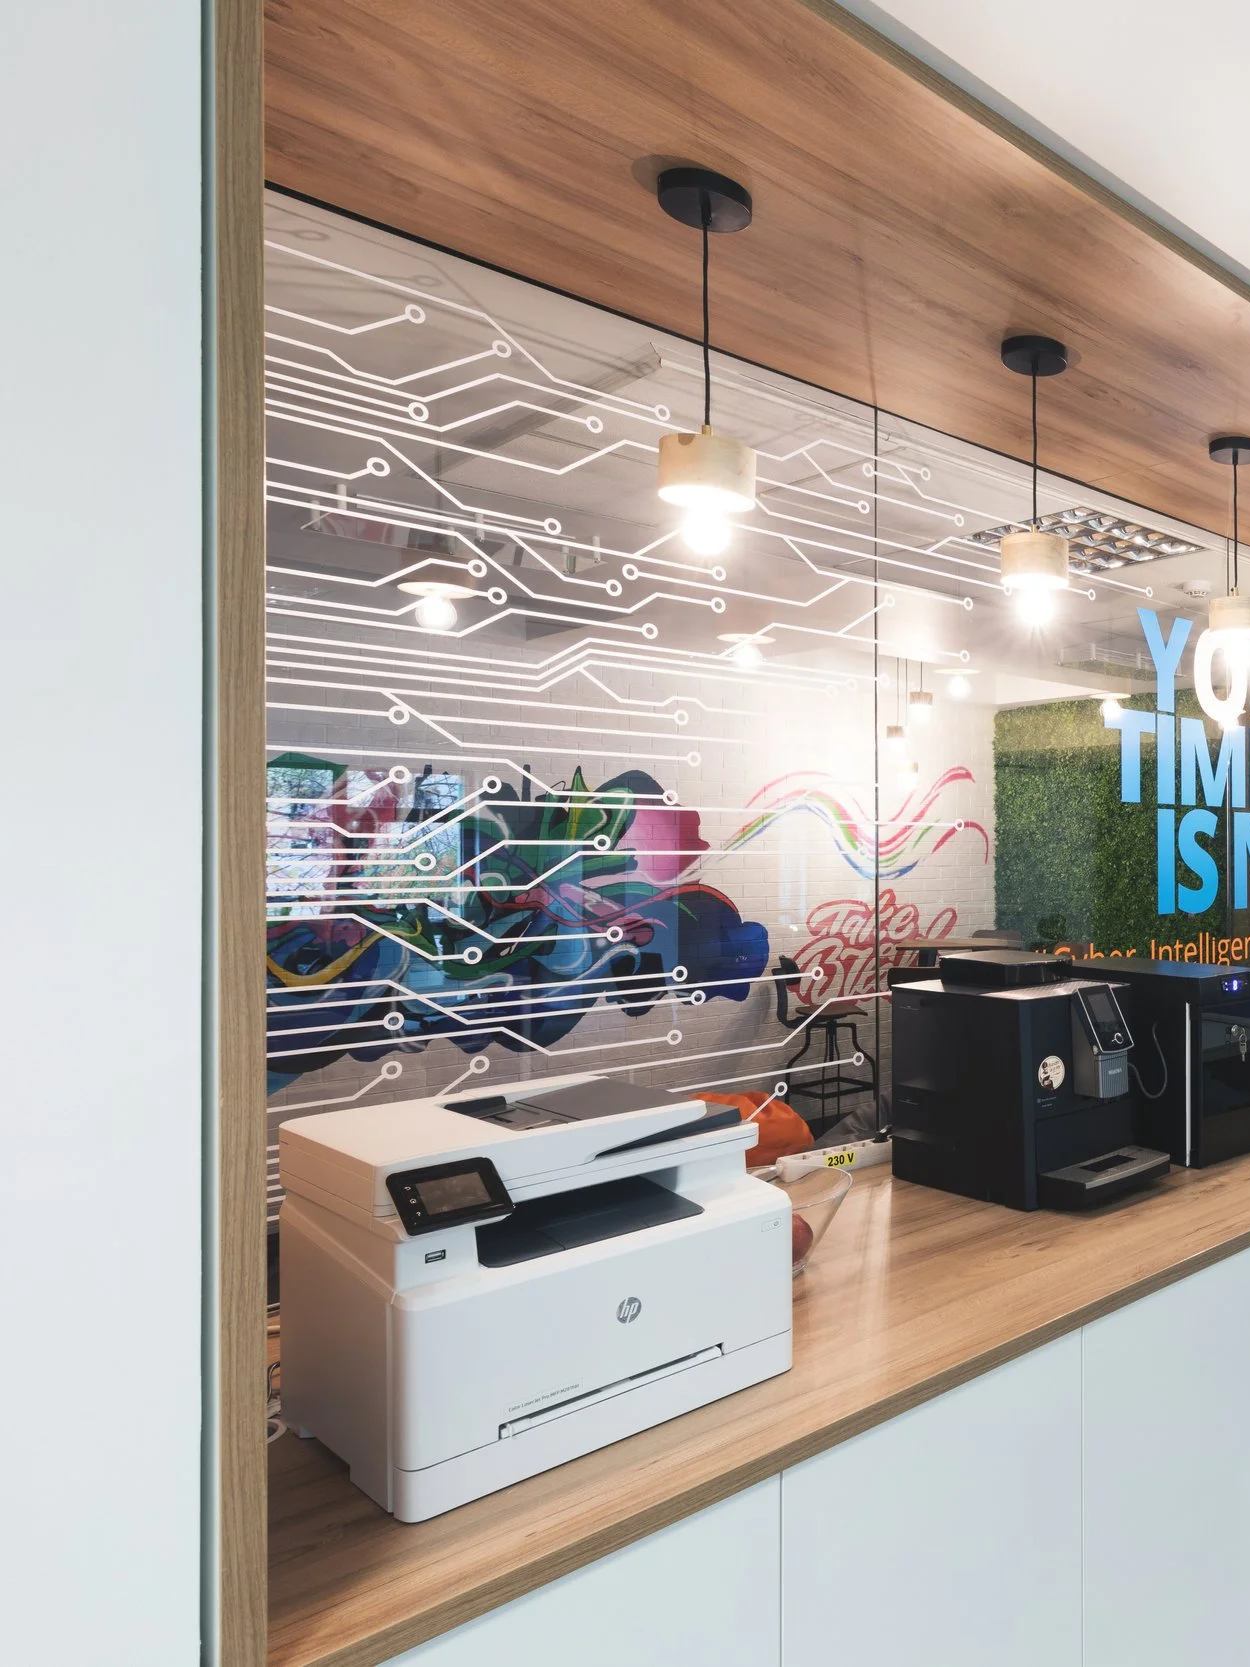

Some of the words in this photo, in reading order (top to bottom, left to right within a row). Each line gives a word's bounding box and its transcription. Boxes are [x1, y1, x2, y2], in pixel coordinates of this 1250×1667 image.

[1157, 808, 1218, 915] IS
[807, 888, 920, 945] Take
[828, 1155, 844, 1167] 230
[847, 1153, 854, 1162] V
[619, 1297, 640, 1324] hp
[508, 1404, 521, 1413] Color
